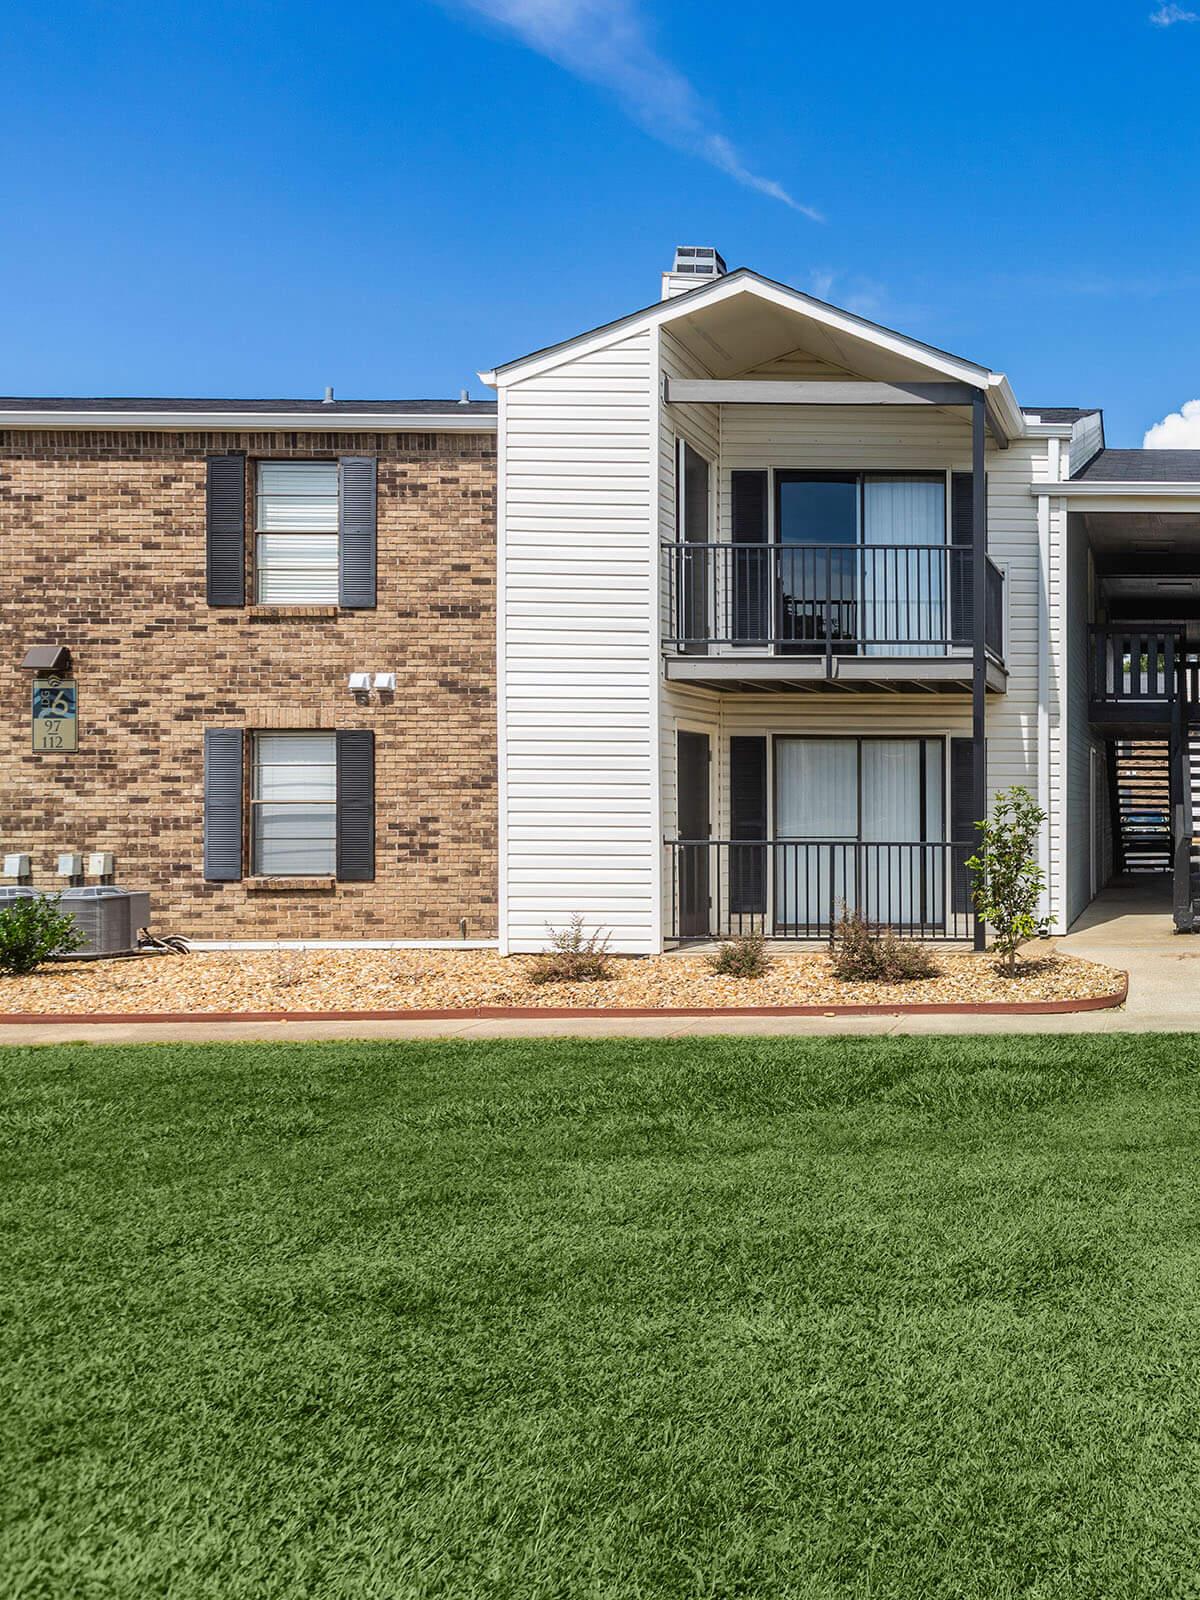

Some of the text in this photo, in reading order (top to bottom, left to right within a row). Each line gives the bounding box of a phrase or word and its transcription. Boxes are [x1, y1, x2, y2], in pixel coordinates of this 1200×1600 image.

[41, 690, 50, 715] LDG
[52, 690, 68, 715] 6
[44, 719, 62, 732] 97
[42, 735, 63, 748] 112
